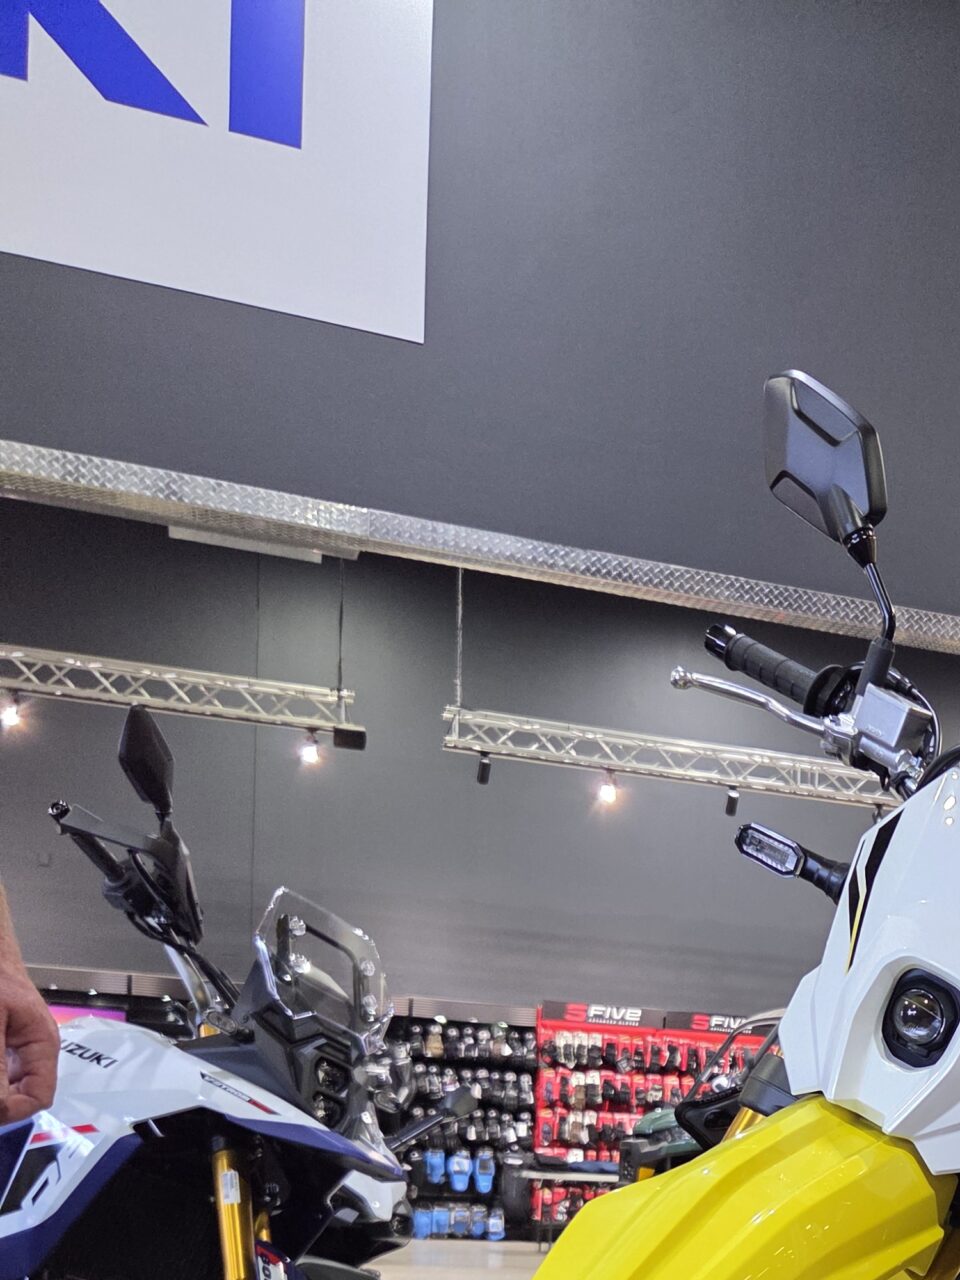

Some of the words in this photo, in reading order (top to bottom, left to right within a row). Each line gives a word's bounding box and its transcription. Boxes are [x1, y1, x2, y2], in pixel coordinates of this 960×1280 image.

[588, 1005, 642, 1021] FIVE
[710, 1015, 752, 1030] FIV
[60, 1039, 119, 1069] UZUKI
